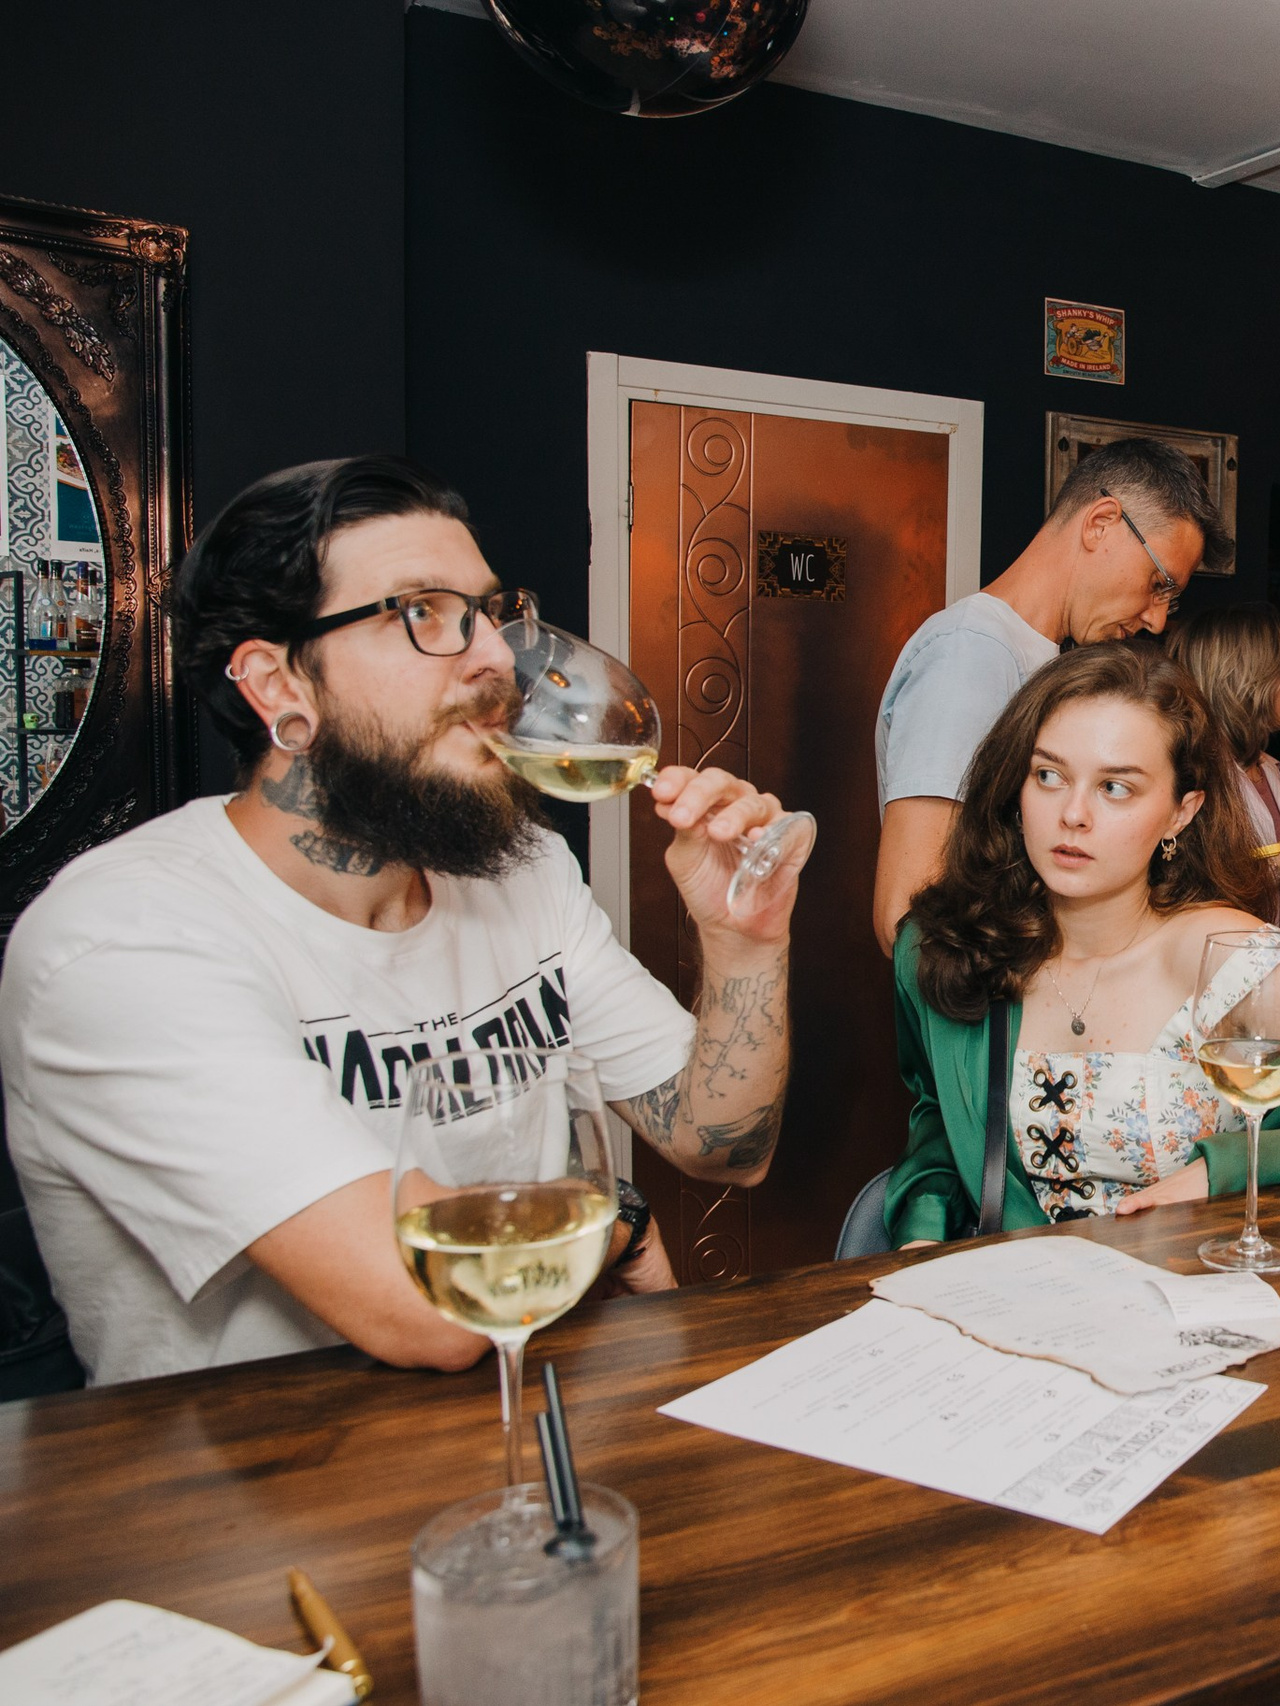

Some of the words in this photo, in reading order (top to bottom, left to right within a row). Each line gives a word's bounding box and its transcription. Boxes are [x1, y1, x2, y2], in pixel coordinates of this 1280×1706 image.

[1056, 308, 1095, 319] SHANKY'S
[1095, 312, 1116, 326] WHIP
[1060, 357, 1078, 369] MADE
[1086, 363, 1111, 371] IRELAND
[790, 552, 815, 582] WC
[413, 1011, 460, 1034] THE
